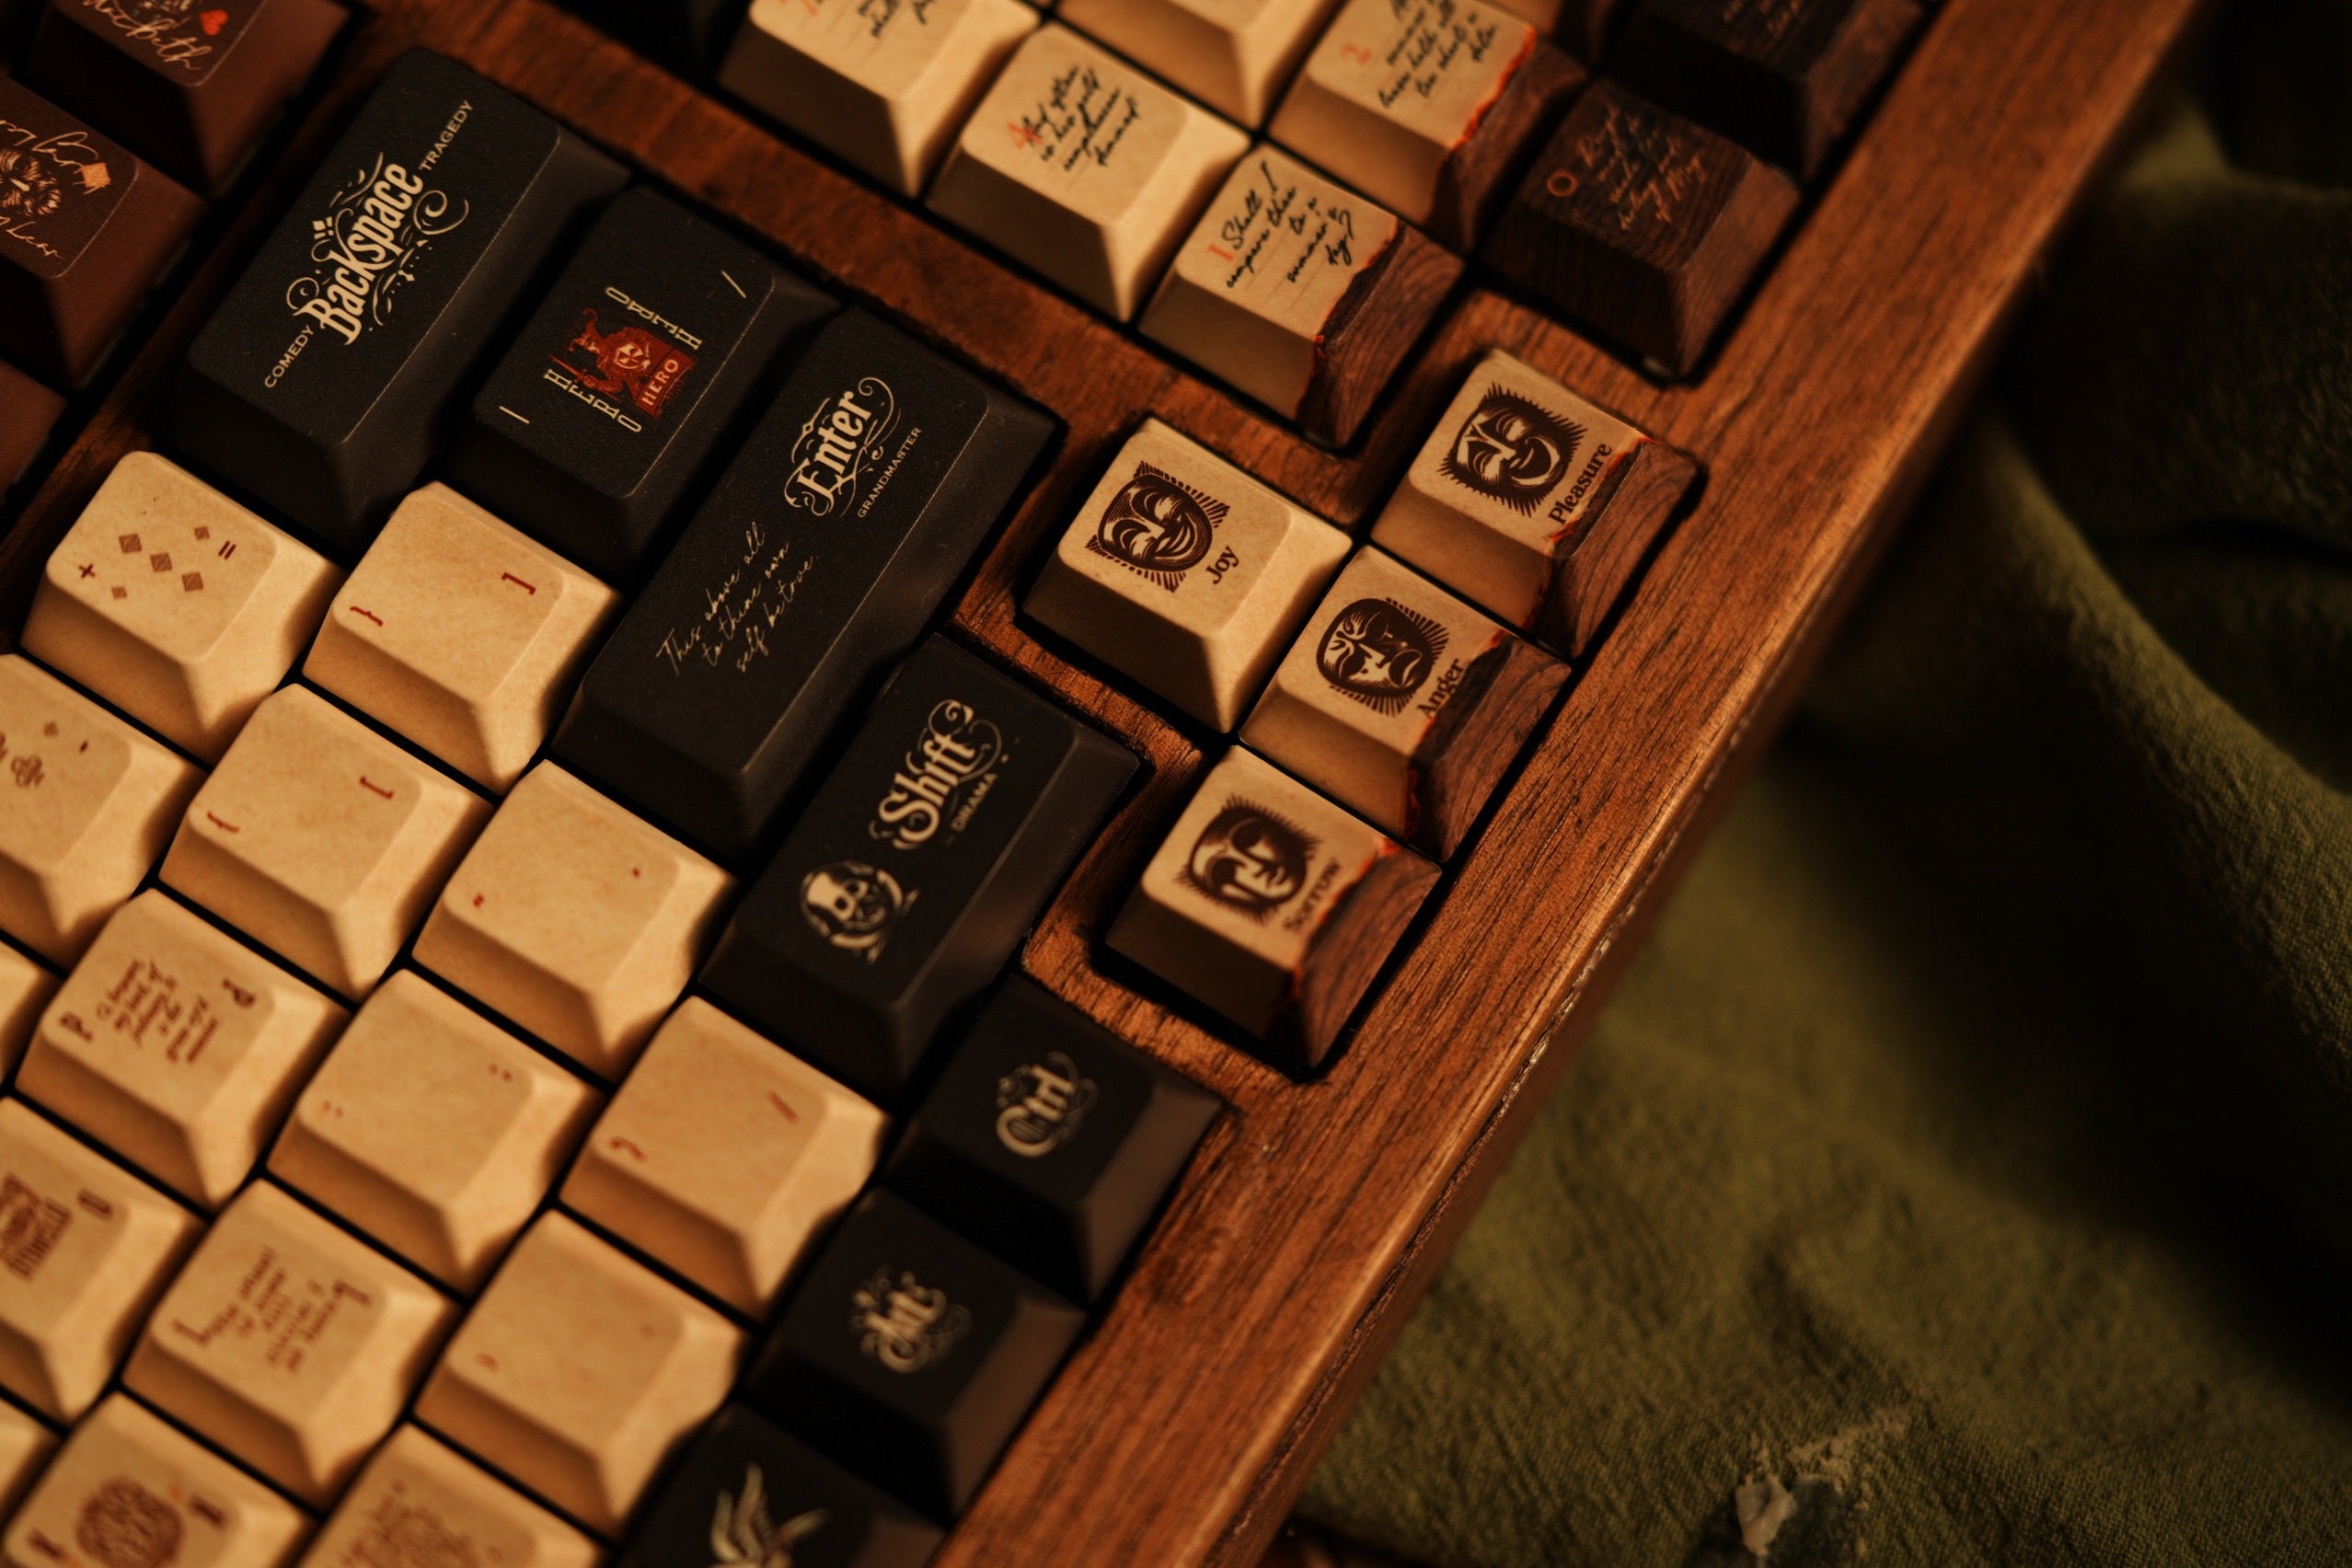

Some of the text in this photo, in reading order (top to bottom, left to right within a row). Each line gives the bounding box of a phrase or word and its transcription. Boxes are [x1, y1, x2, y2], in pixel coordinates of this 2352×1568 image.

[418, 99, 474, 172] TRAGEDY
[1222, 189, 1262, 250] Shall
[1226, 187, 1297, 288] compare thee
[1288, 213, 1307, 236] to
[293, 163, 424, 346] Backspace
[605, 286, 703, 351] HERO
[264, 324, 314, 388] COMEDY
[640, 359, 679, 407] HERO
[543, 368, 642, 432] HERO
[784, 391, 873, 517] Enter
[857, 427, 922, 518] GRANDMASTER
[1548, 440, 1613, 525] Pleasure
[1205, 545, 1240, 584] Joy
[655, 521, 765, 675] This above all
[702, 641, 723, 666] to
[736, 625, 769, 673] self
[1416, 657, 1465, 720] Anger
[879, 732, 976, 846] Shift
[951, 773, 997, 831] DRAMA
[1283, 858, 1342, 931] Sorrow
[997, 1065, 1076, 1157] Ctrl
